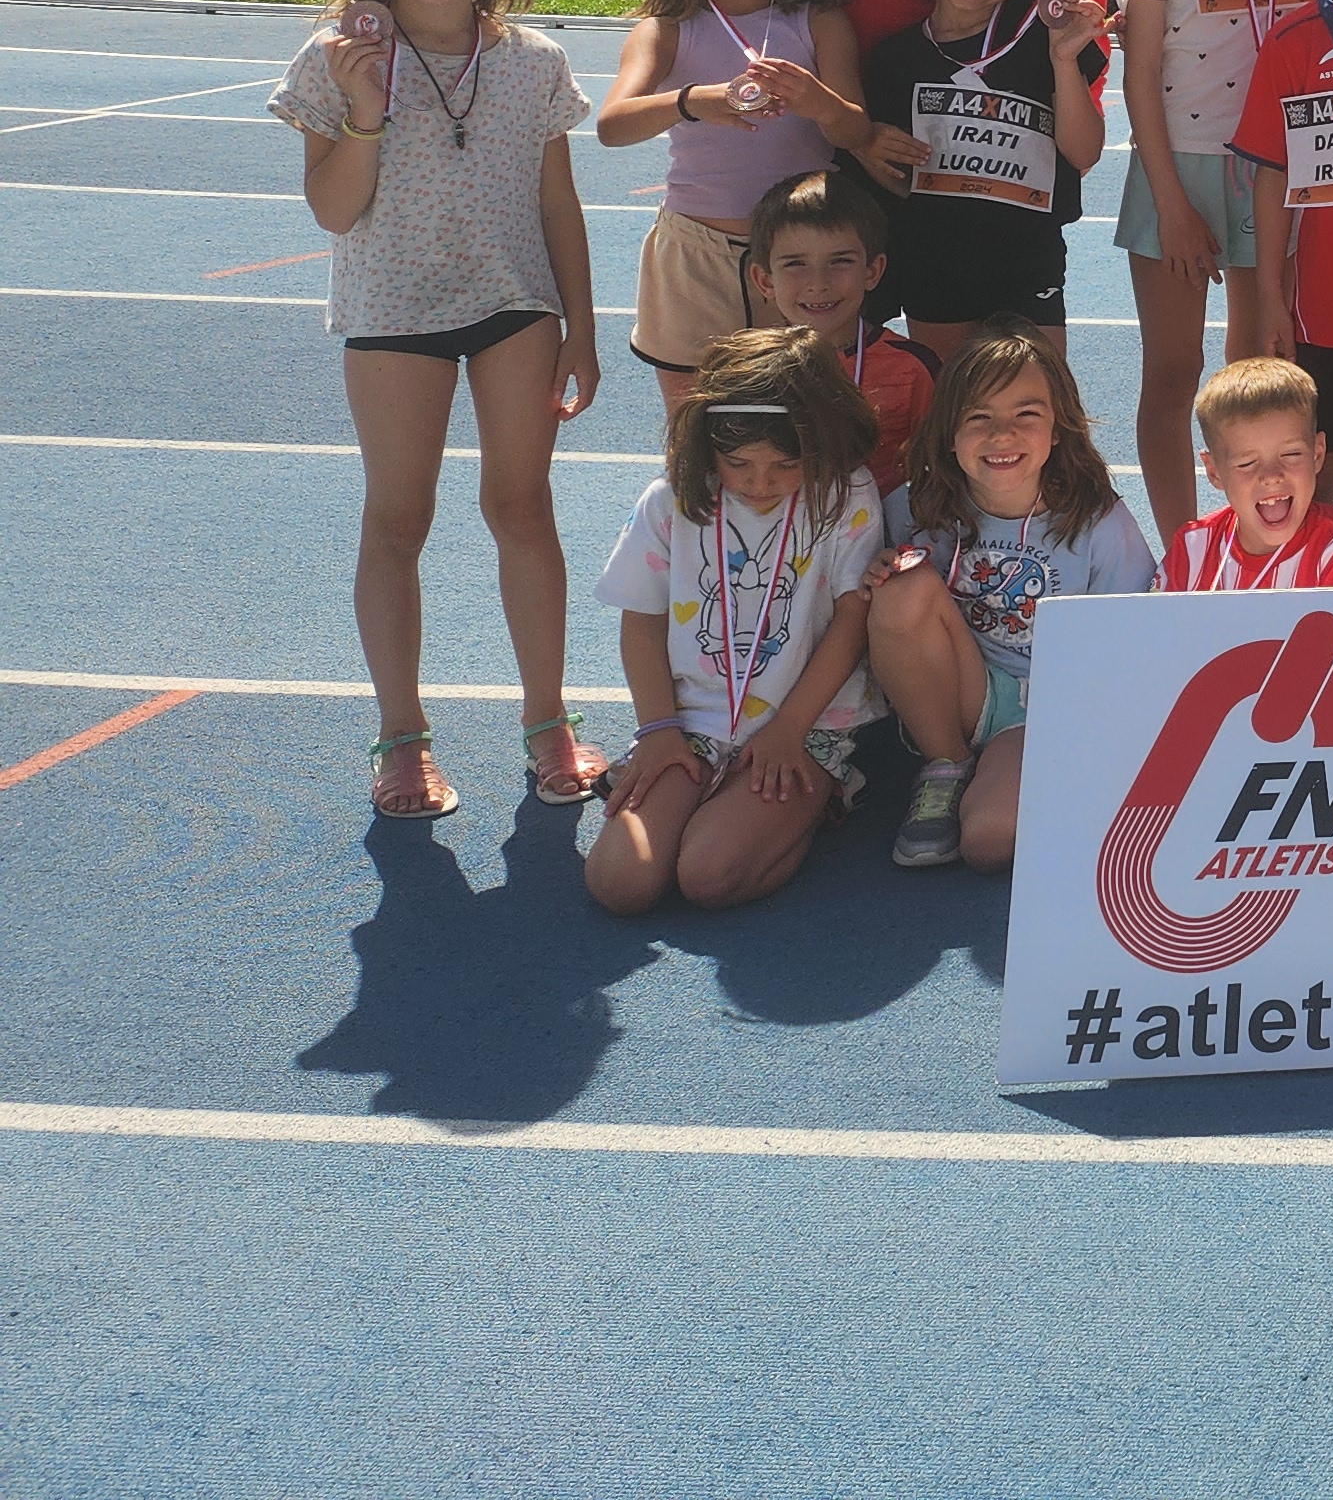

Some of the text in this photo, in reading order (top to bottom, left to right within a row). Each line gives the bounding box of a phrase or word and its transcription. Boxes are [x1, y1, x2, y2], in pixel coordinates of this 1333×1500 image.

[948, 92, 1032, 126] A4XKM
[952, 125, 1020, 149] IRATI
[938, 154, 1028, 181] LUQUIN
[960, 183, 992, 193] 2024
[978, 539, 1051, 564] MALLORCA
